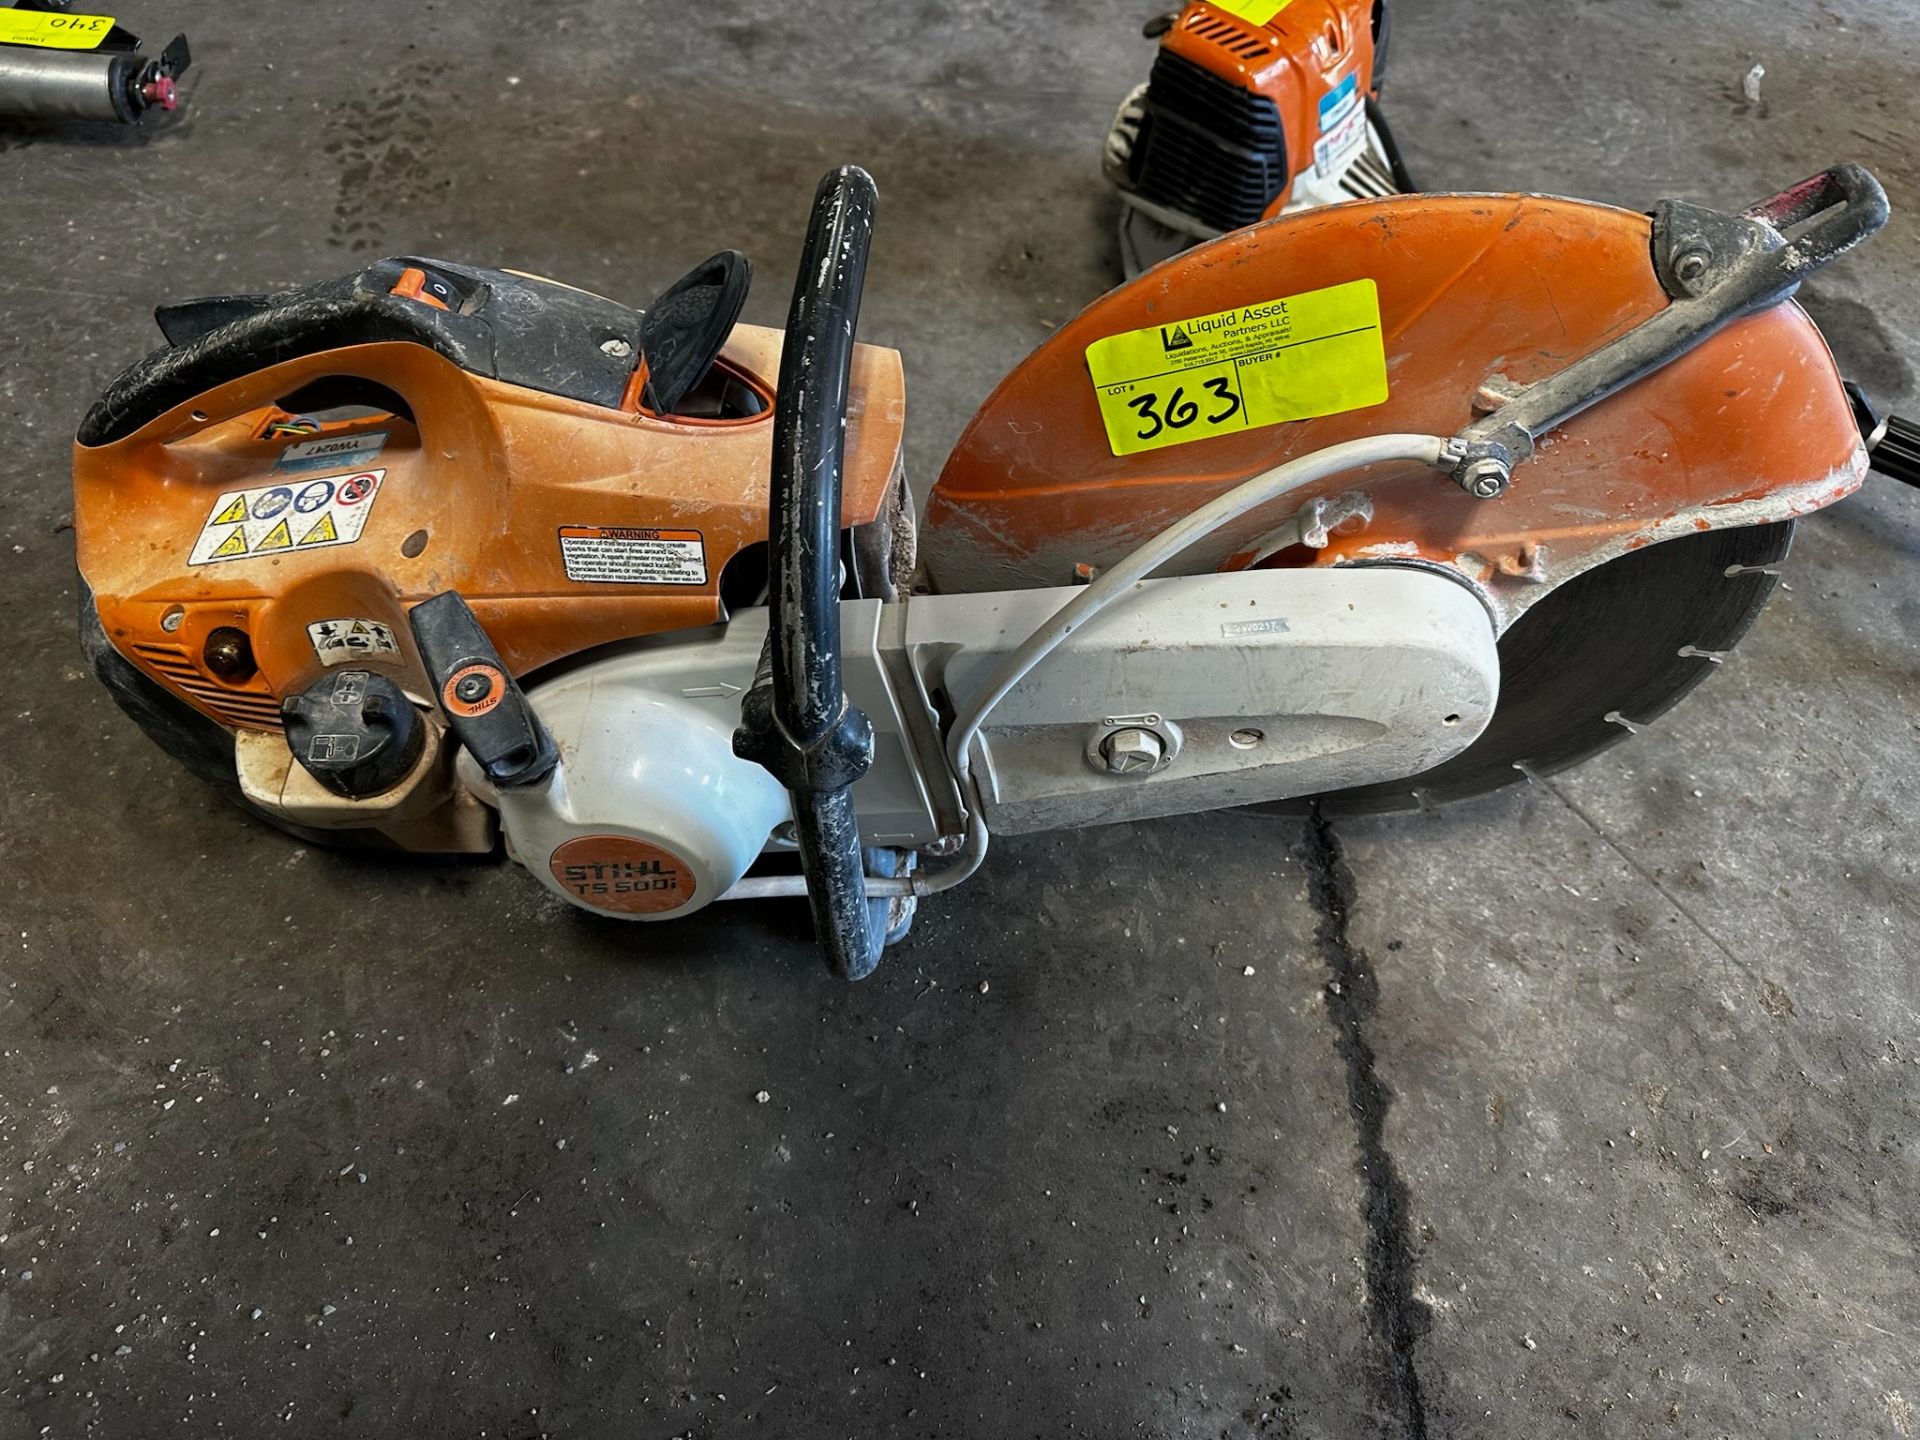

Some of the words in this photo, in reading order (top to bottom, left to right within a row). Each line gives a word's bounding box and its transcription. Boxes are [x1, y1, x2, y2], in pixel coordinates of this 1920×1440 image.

[50, 18, 106, 31] 340
[1187, 311, 1237, 335] Liquid
[1242, 301, 1288, 323] Asset
[1223, 322, 1268, 338] Partners
[1270, 316, 1291, 328] LLC
[1239, 353, 1273, 367] BUYER
[1107, 385, 1127, 396] LOT
[1127, 376, 1240, 440] 363
[608, 530, 660, 539] WARNING
[563, 538, 595, 546] Operation
[616, 541, 650, 549] equipment
[568, 558, 580, 566] The
[468, 697, 497, 714] STIHL
[565, 860, 677, 881] STIHL
[574, 882, 609, 895] TS
[615, 878, 677, 894] 500i
